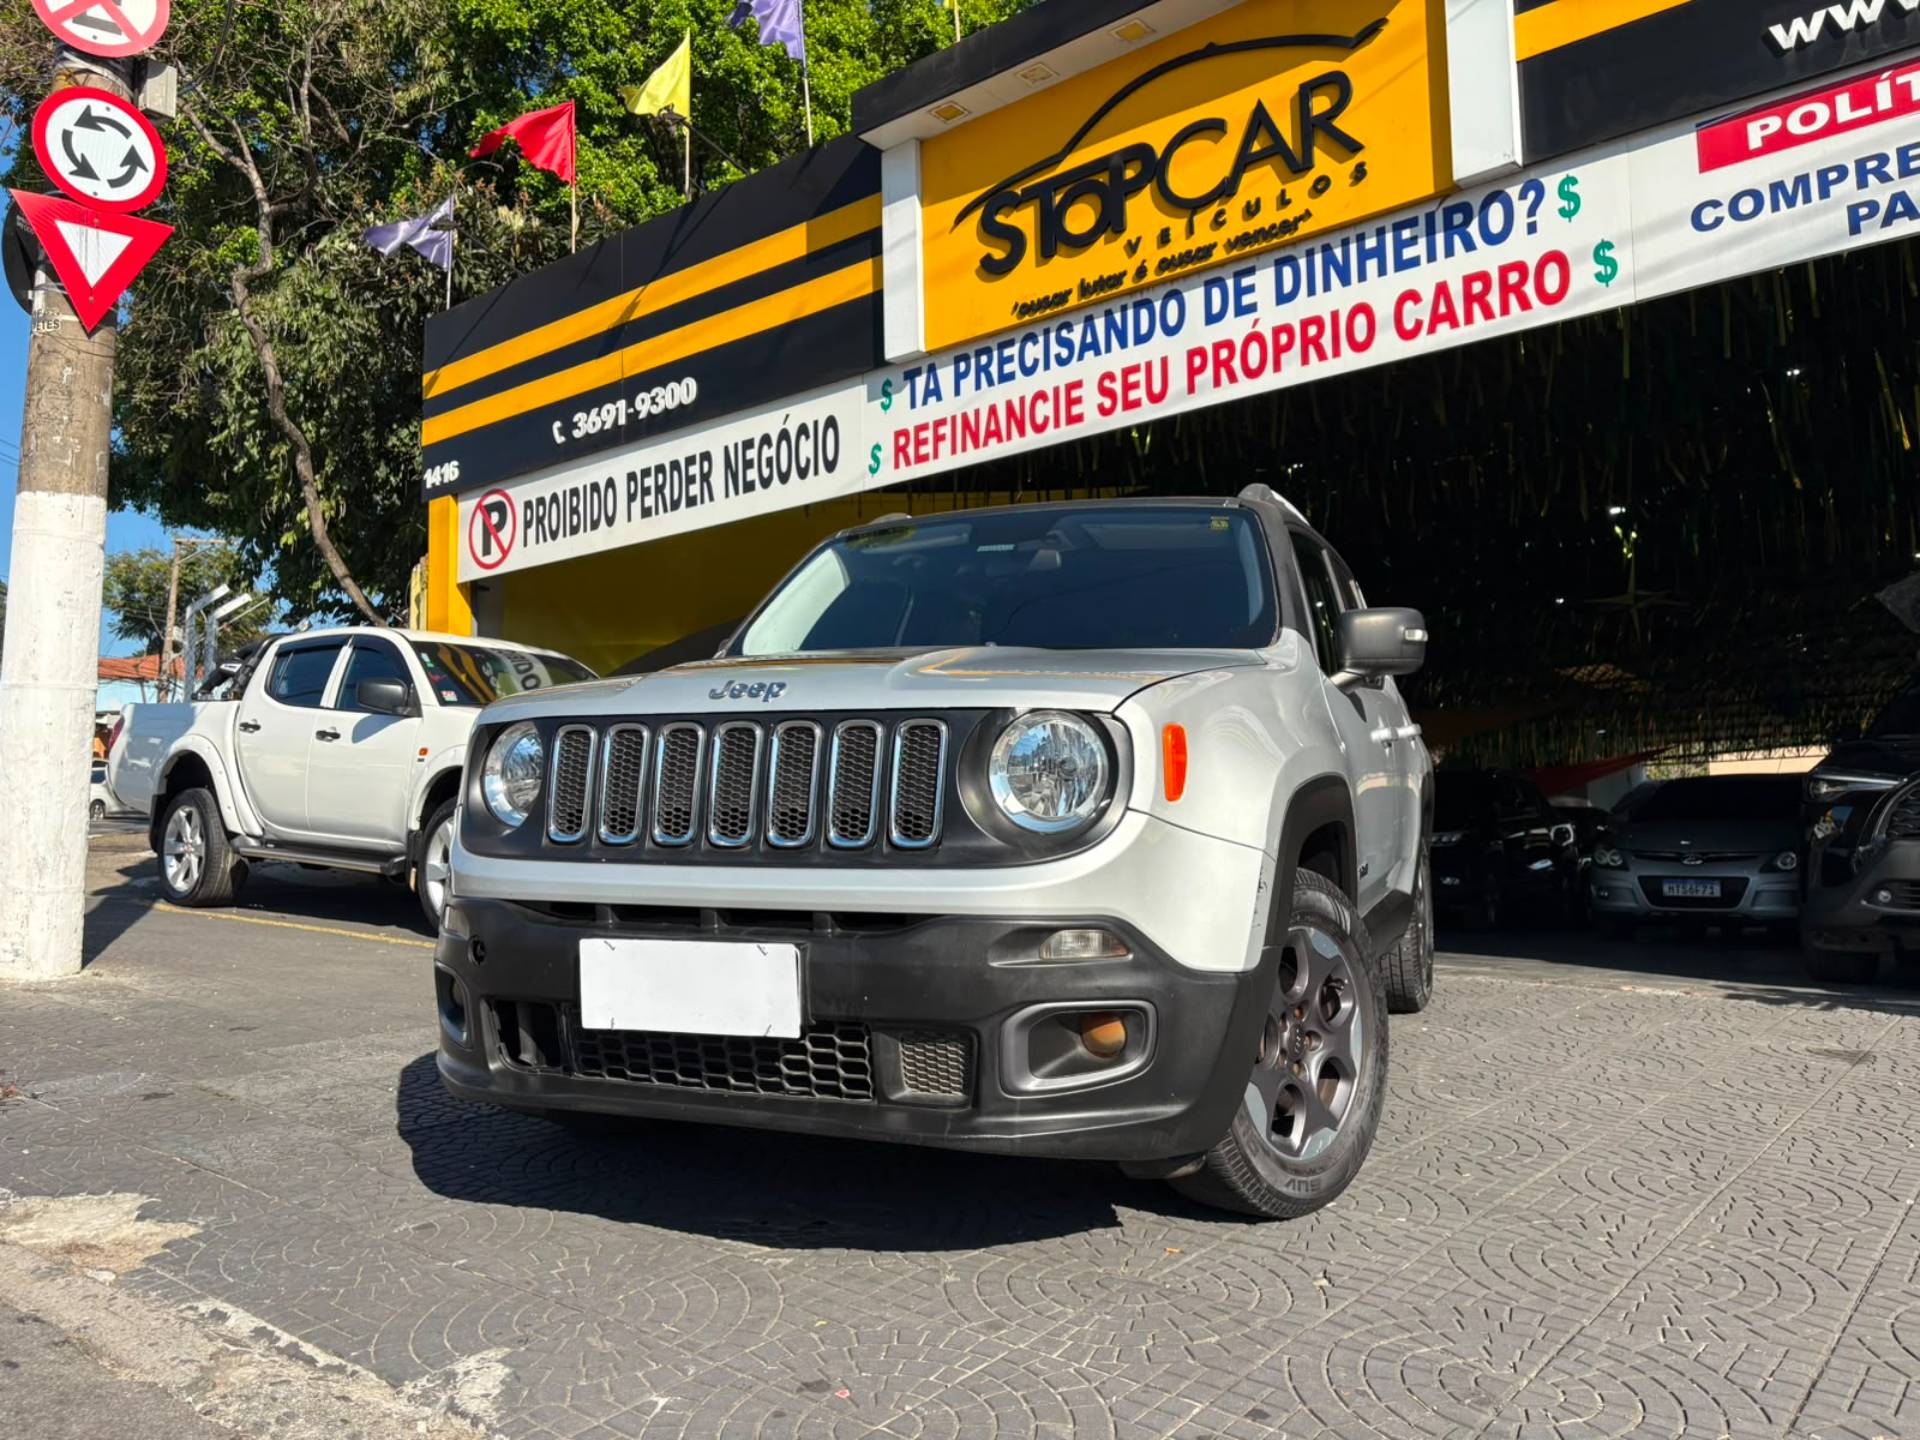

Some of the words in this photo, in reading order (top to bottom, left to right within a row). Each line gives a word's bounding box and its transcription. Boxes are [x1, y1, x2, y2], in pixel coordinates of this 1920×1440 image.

[1768, 0, 1920, 50] ww
[979, 70, 1365, 276] STOPCAR
[1126, 161, 1367, 256] VEÍCULOS
[1690, 141, 1920, 232] COMPRE
[903, 362, 943, 410] TA
[953, 288, 1186, 398] PRECISANDO
[1204, 265, 1258, 326] DE
[1274, 178, 1546, 306] DINHEIRO?
[1080, 269, 1128, 299] lutar
[1158, 240, 1218, 273] ousar
[893, 379, 1085, 470] REFINANCIE
[1097, 355, 1169, 417] SEU
[1186, 302, 1376, 396] PRÓPRIO
[1393, 250, 1571, 342] CARRO
[572, 376, 698, 439] 3691-9300
[423, 460, 460, 489] 1416
[523, 476, 617, 548] PROIBIDO
[626, 450, 715, 523] PERDER
[724, 414, 840, 499] NEGÓCIO
[708, 679, 787, 703] Jeep
